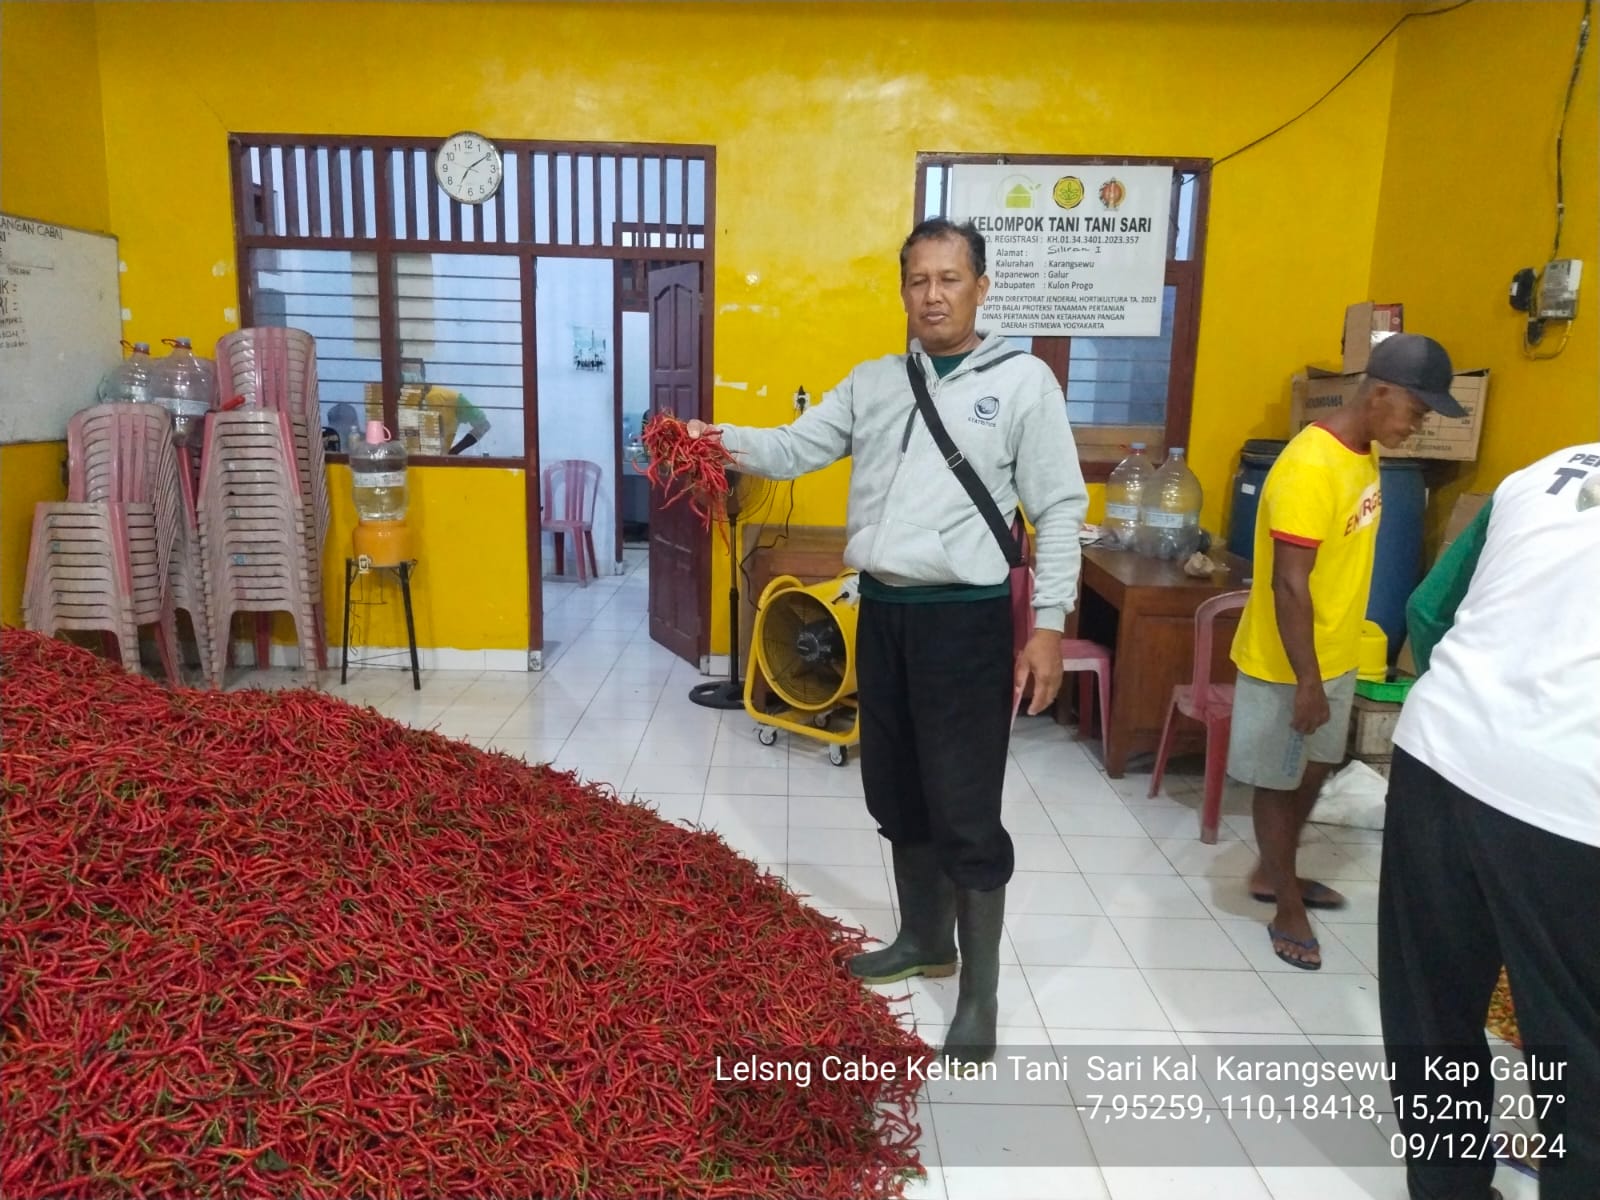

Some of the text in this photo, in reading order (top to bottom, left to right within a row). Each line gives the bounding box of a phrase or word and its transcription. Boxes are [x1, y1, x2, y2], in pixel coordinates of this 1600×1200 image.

[454, 144, 461, 152] 11
[464, 140, 473, 149] 12
[446, 152, 455, 161] 10
[442, 164, 448, 172] 9
[490, 165, 496, 173] 3
[447, 176, 453, 185] 8
[487, 177, 493, 185] 4
[457, 185, 462, 193] 7
[467, 188, 473, 196] 6
[479, 185, 485, 194] 5
[968, 216, 1151, 233] KELOMPOK TANI TANI SARI
[995, 235, 1039, 243] REGISTRASI
[996, 249, 1023, 257] Alamat
[996, 259, 1034, 268] Kalurahan
[1049, 260, 1095, 270] Karangsewu
[995, 271, 1040, 279] Kapanewon
[1048, 270, 1070, 279] Galur
[995, 280, 1035, 290] Kabupaten
[1048, 281, 1070, 289] Kulon
[1072, 281, 1094, 291] Progo
[1022, 304, 1053, 312] PROTEKSI
[1054, 304, 1087, 312] TANAMAN
[1089, 304, 1125, 312] PERTANIAN
[982, 312, 1001, 320] DINAS
[1057, 313, 1096, 321] KETAHANAN
[1097, 313, 1125, 321] PANGAN
